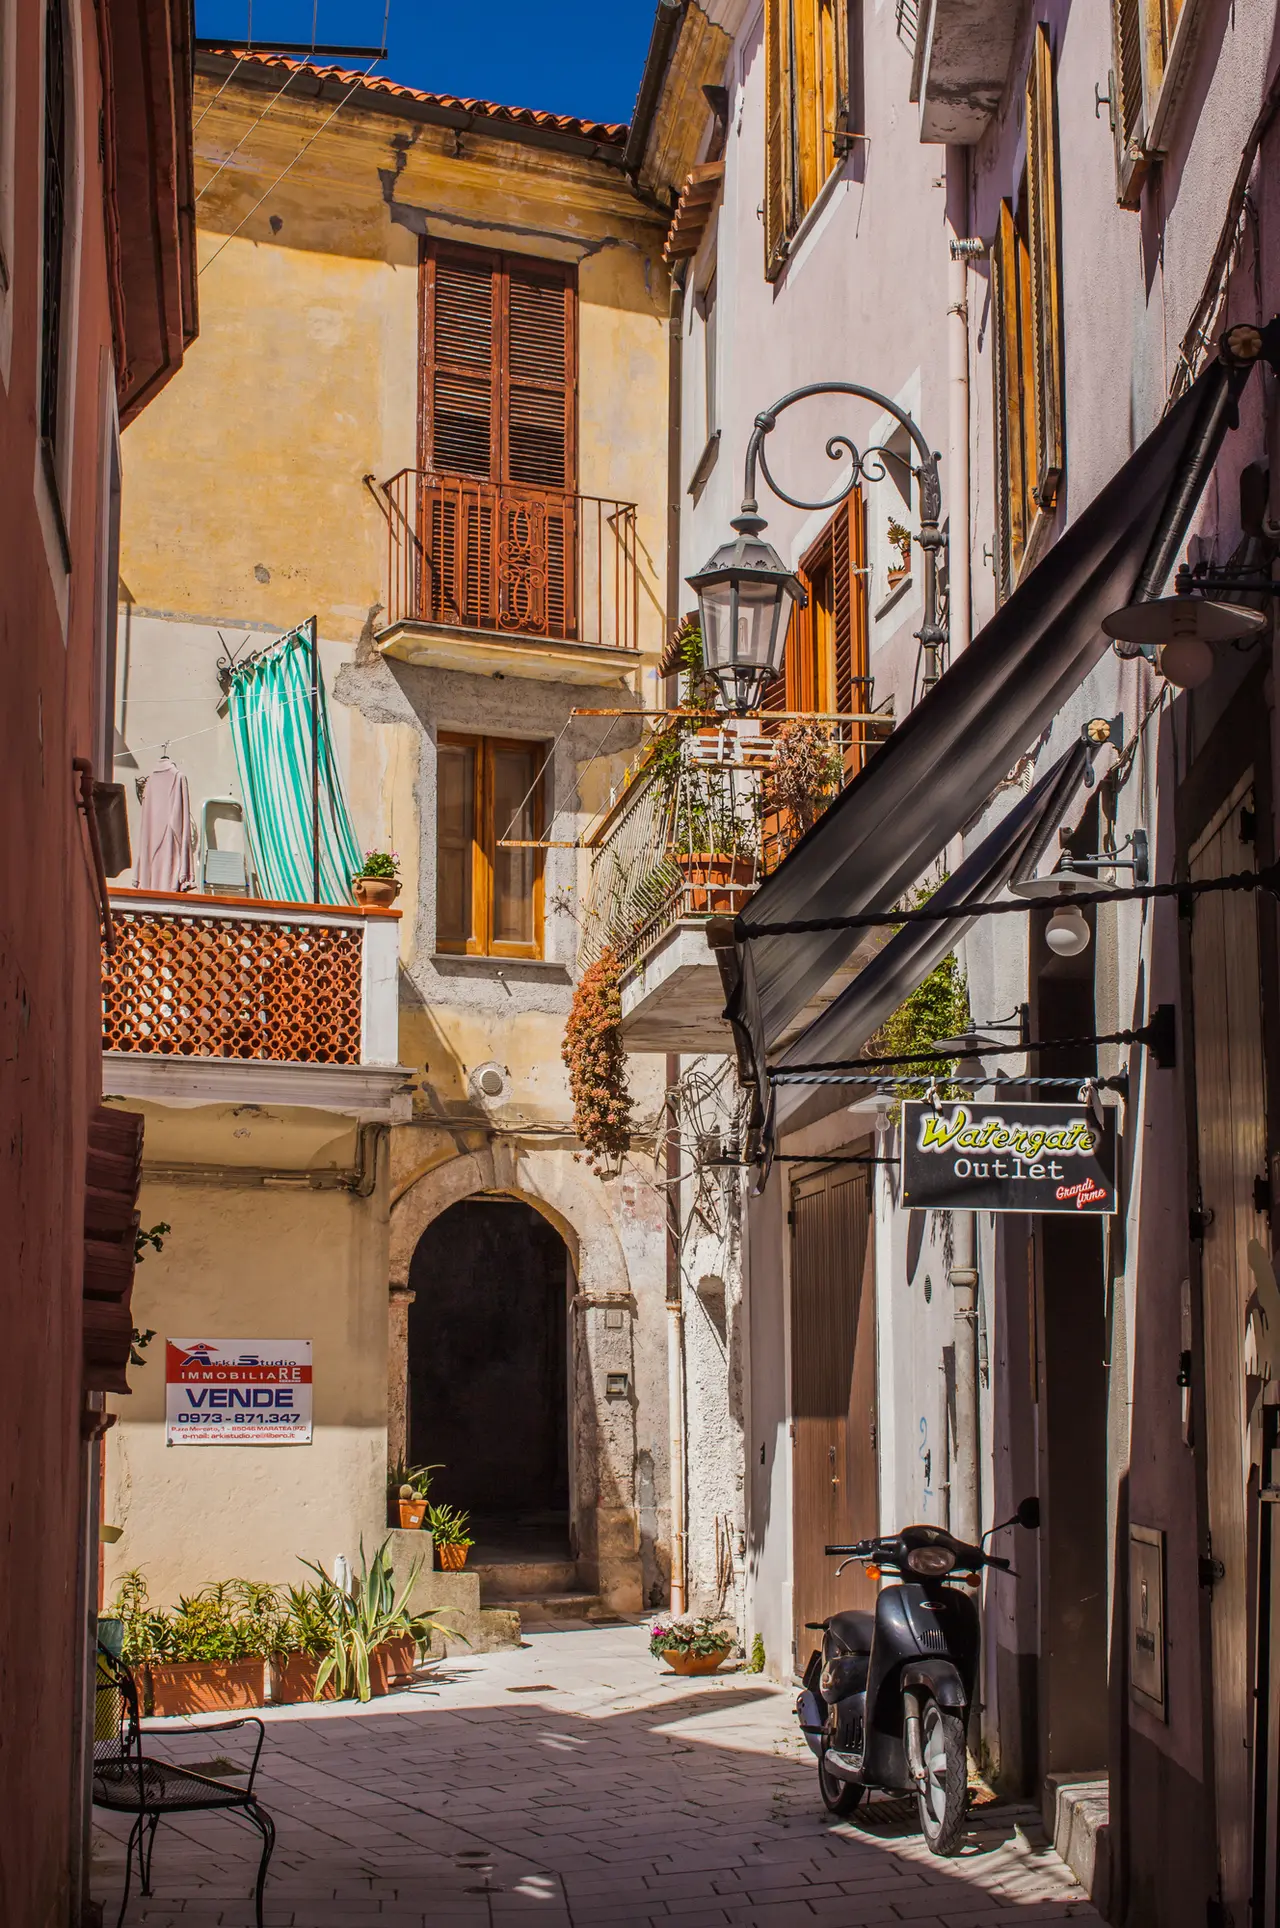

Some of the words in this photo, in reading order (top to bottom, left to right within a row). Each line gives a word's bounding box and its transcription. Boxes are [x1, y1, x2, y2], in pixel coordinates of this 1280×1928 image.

[922, 1110, 1096, 1158] Watergate
[954, 1158, 1065, 1180] Outlet
[1056, 1178, 1094, 1199] Grandi
[1076, 1187, 1106, 1209] firme
[185, 1388, 294, 1408] VENDE
